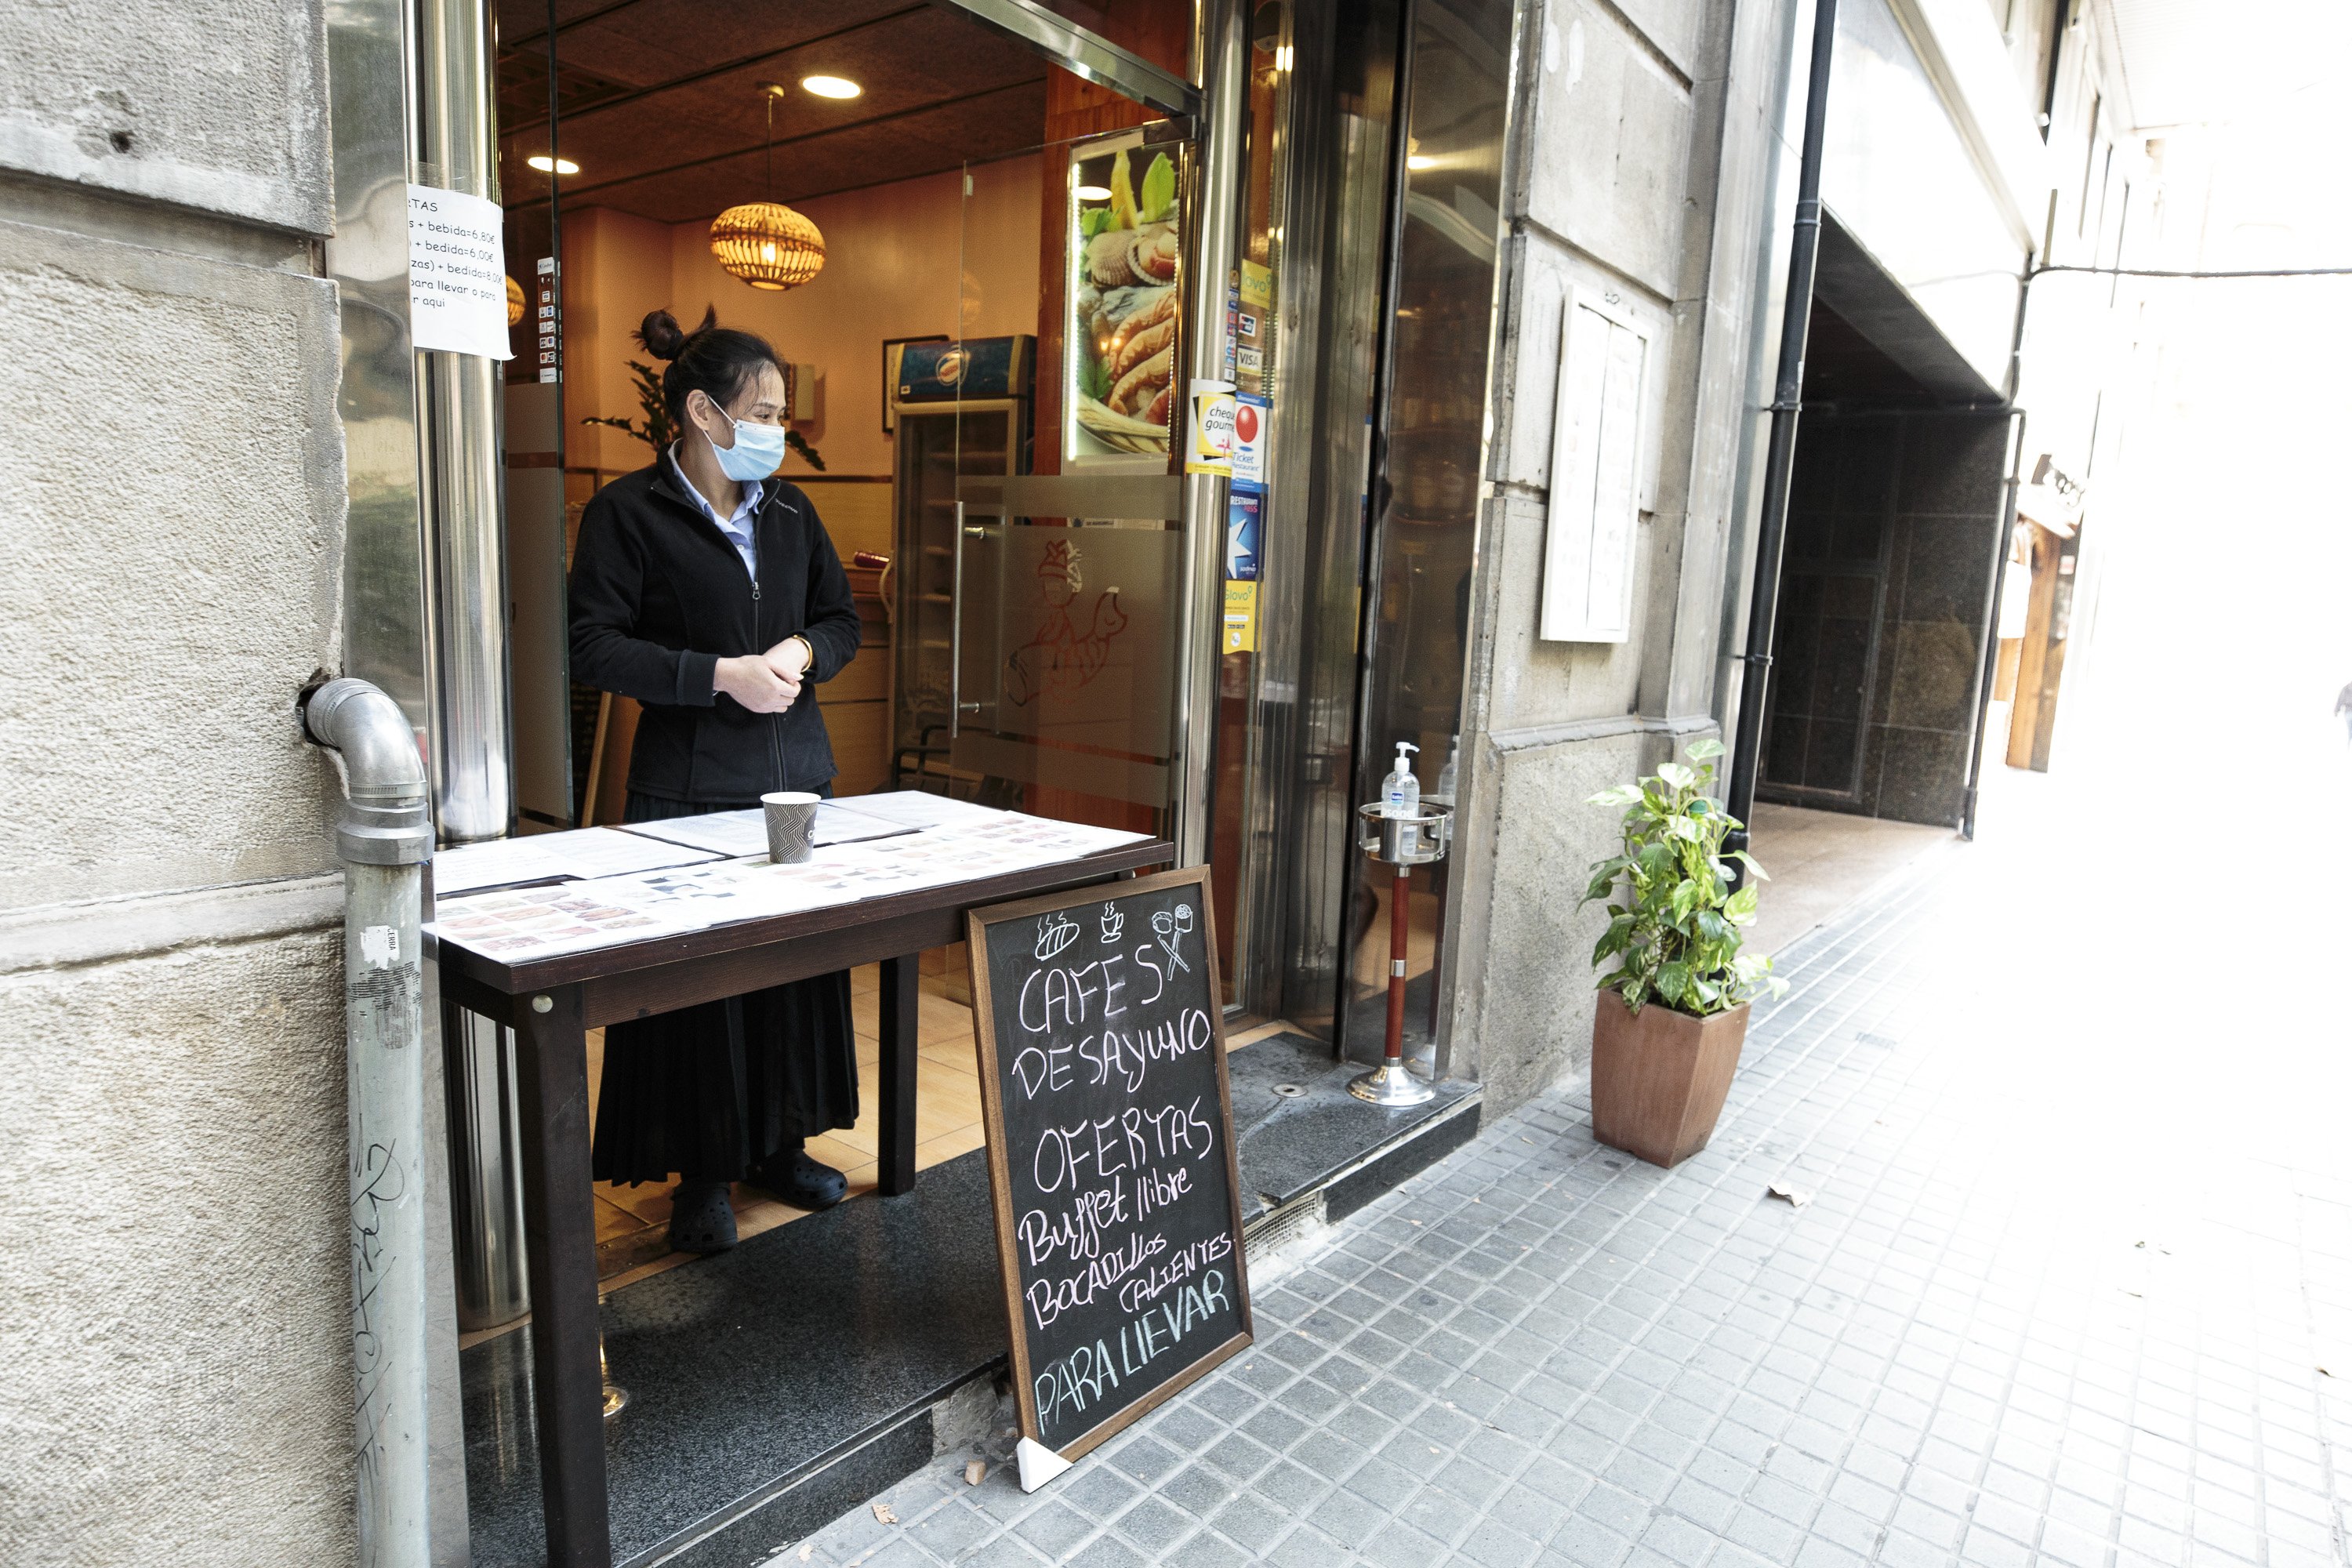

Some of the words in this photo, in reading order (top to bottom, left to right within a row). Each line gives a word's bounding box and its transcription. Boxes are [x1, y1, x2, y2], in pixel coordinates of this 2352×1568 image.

[423, 298, 445, 309] aqui
[437, 280, 468, 294] llevar
[481, 290, 495, 301] para
[1239, 352, 1259, 367] VISA
[1019, 944, 1163, 1033] CAFES
[1011, 1007, 1211, 1101] DESAYUNO
[1034, 1095, 1213, 1192] OFERTAS
[1138, 1167, 1193, 1221] llibre
[1119, 1232, 1232, 1313] CALIENTES
[1035, 1339, 1120, 1436] PARA
